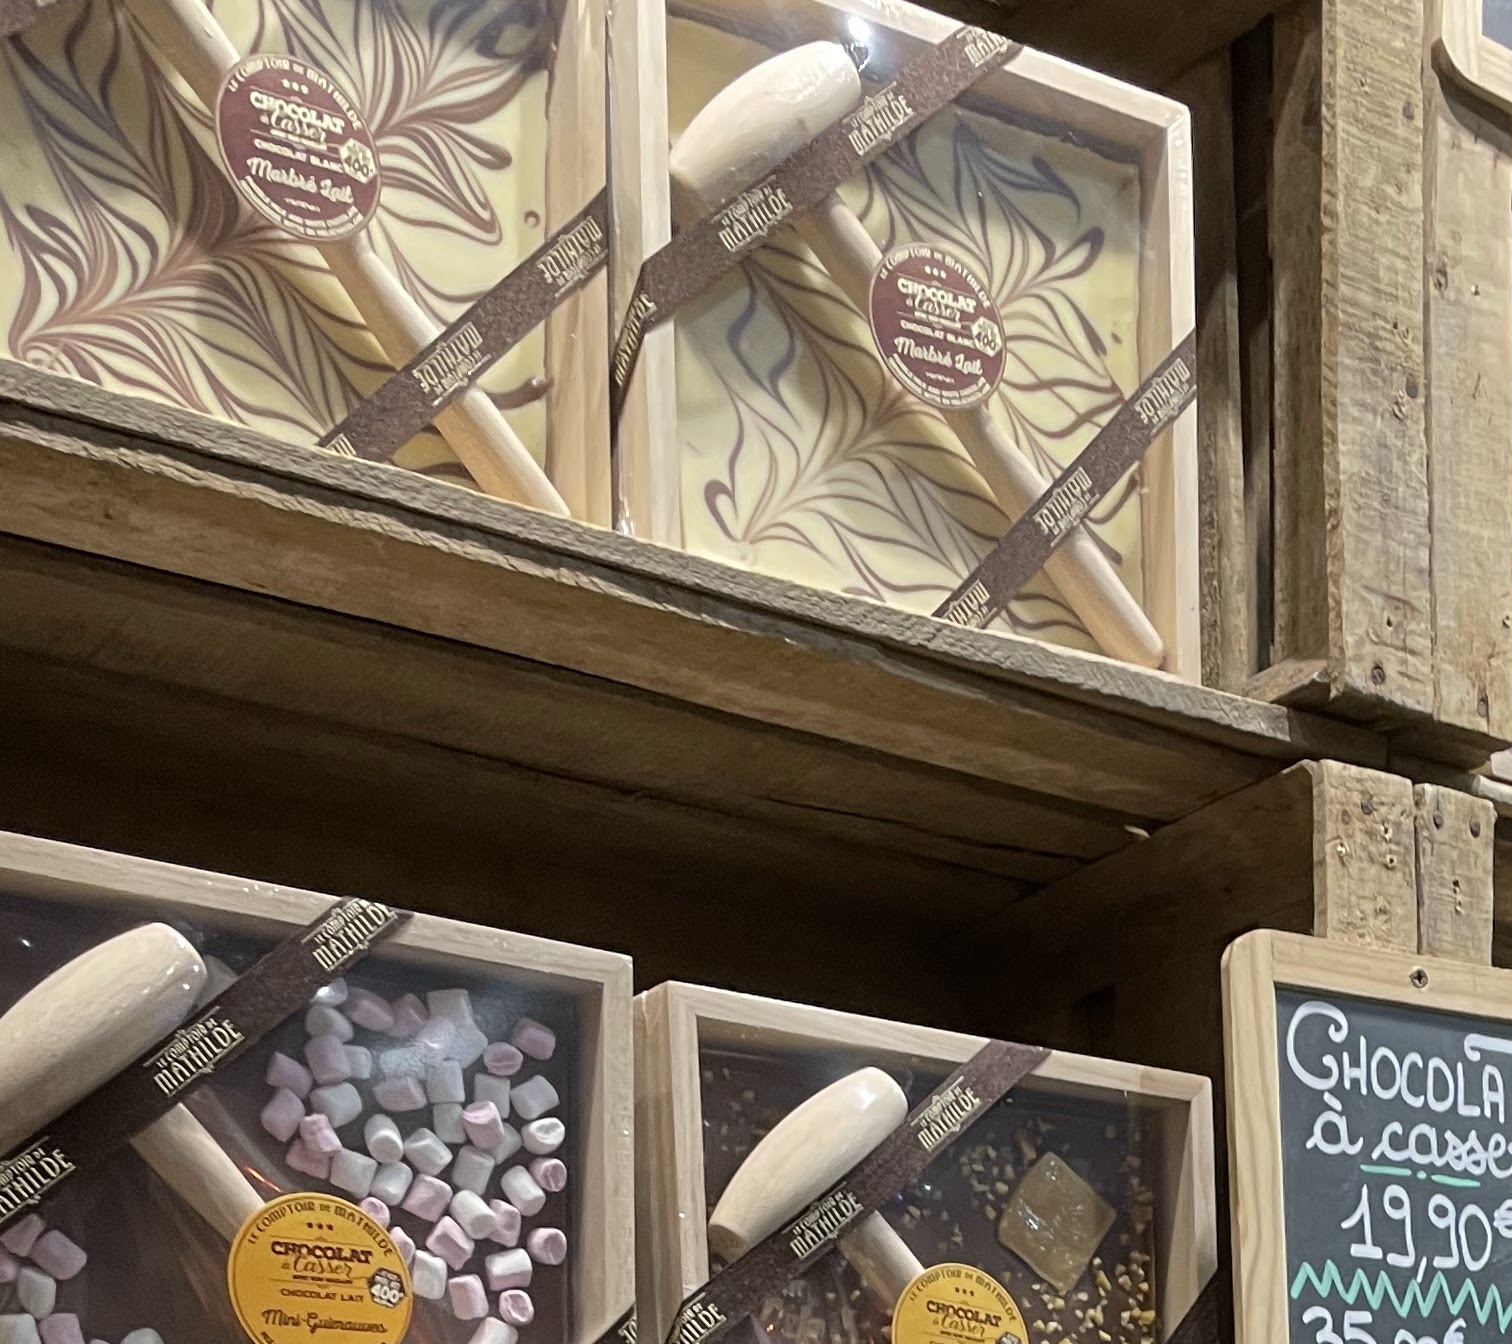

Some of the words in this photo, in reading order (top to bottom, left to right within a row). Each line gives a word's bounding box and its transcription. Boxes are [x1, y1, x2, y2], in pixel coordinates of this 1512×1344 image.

[250, 91, 345, 135] CHOCOLAT
[246, 157, 319, 194] Marbré
[897, 277, 977, 315] CHOCOLAT
[893, 336, 952, 368] Marbré
[312, 901, 398, 971] MATHILDE
[153, 1017, 246, 1098] MATHILDE
[917, 1087, 981, 1152] MATHILDE
[1306, 1092, 1364, 1155] à
[790, 1192, 865, 1260] MATHILDE
[271, 1241, 373, 1265] CHOCOLAT
[293, 1256, 353, 1279] Casser
[280, 1288, 337, 1301] CHOCOLAT
[341, 1292, 365, 1303] LAIT
[926, 1300, 1002, 1327] CHOCOLAT
[941, 1314, 986, 1338] Casser
